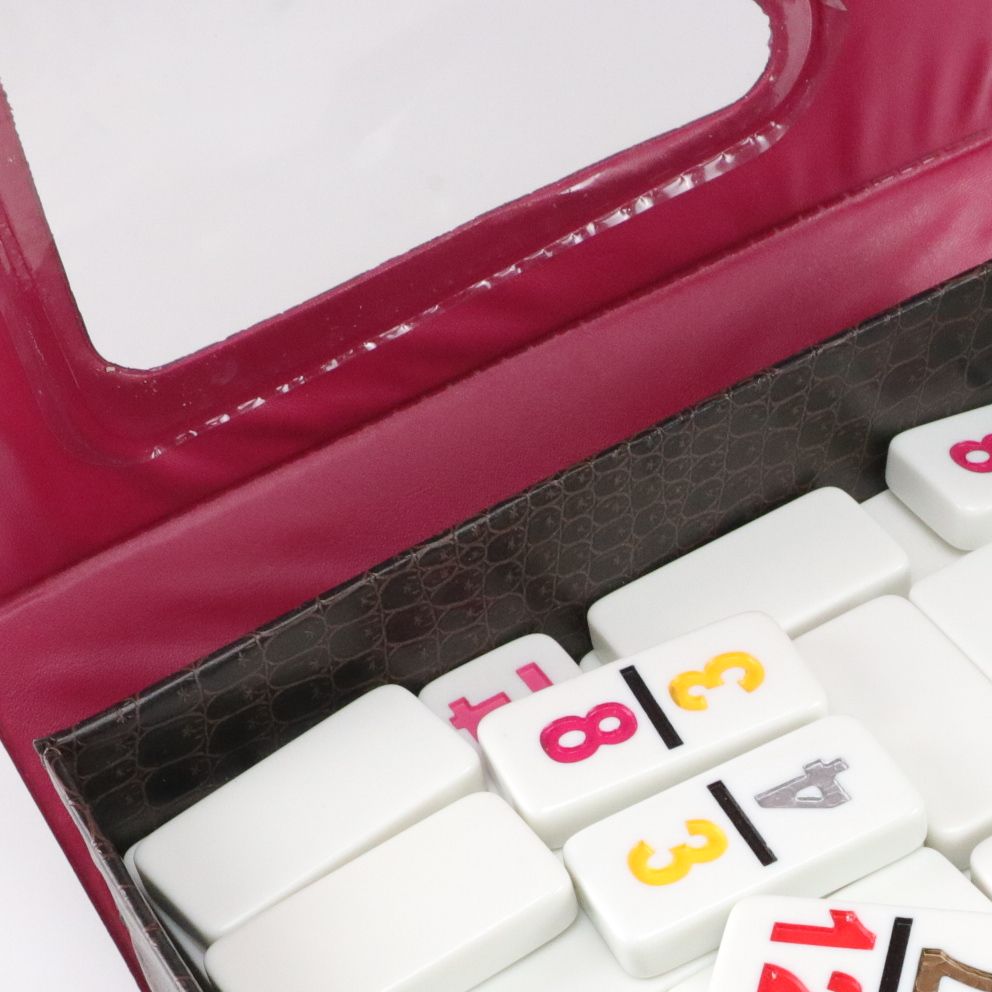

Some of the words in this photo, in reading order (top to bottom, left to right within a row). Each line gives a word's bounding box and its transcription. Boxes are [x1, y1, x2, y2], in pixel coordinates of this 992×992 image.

[667, 651, 766, 712] 3
[540, 702, 639, 764] 8
[754, 757, 850, 809] 4
[627, 818, 729, 887] 3
